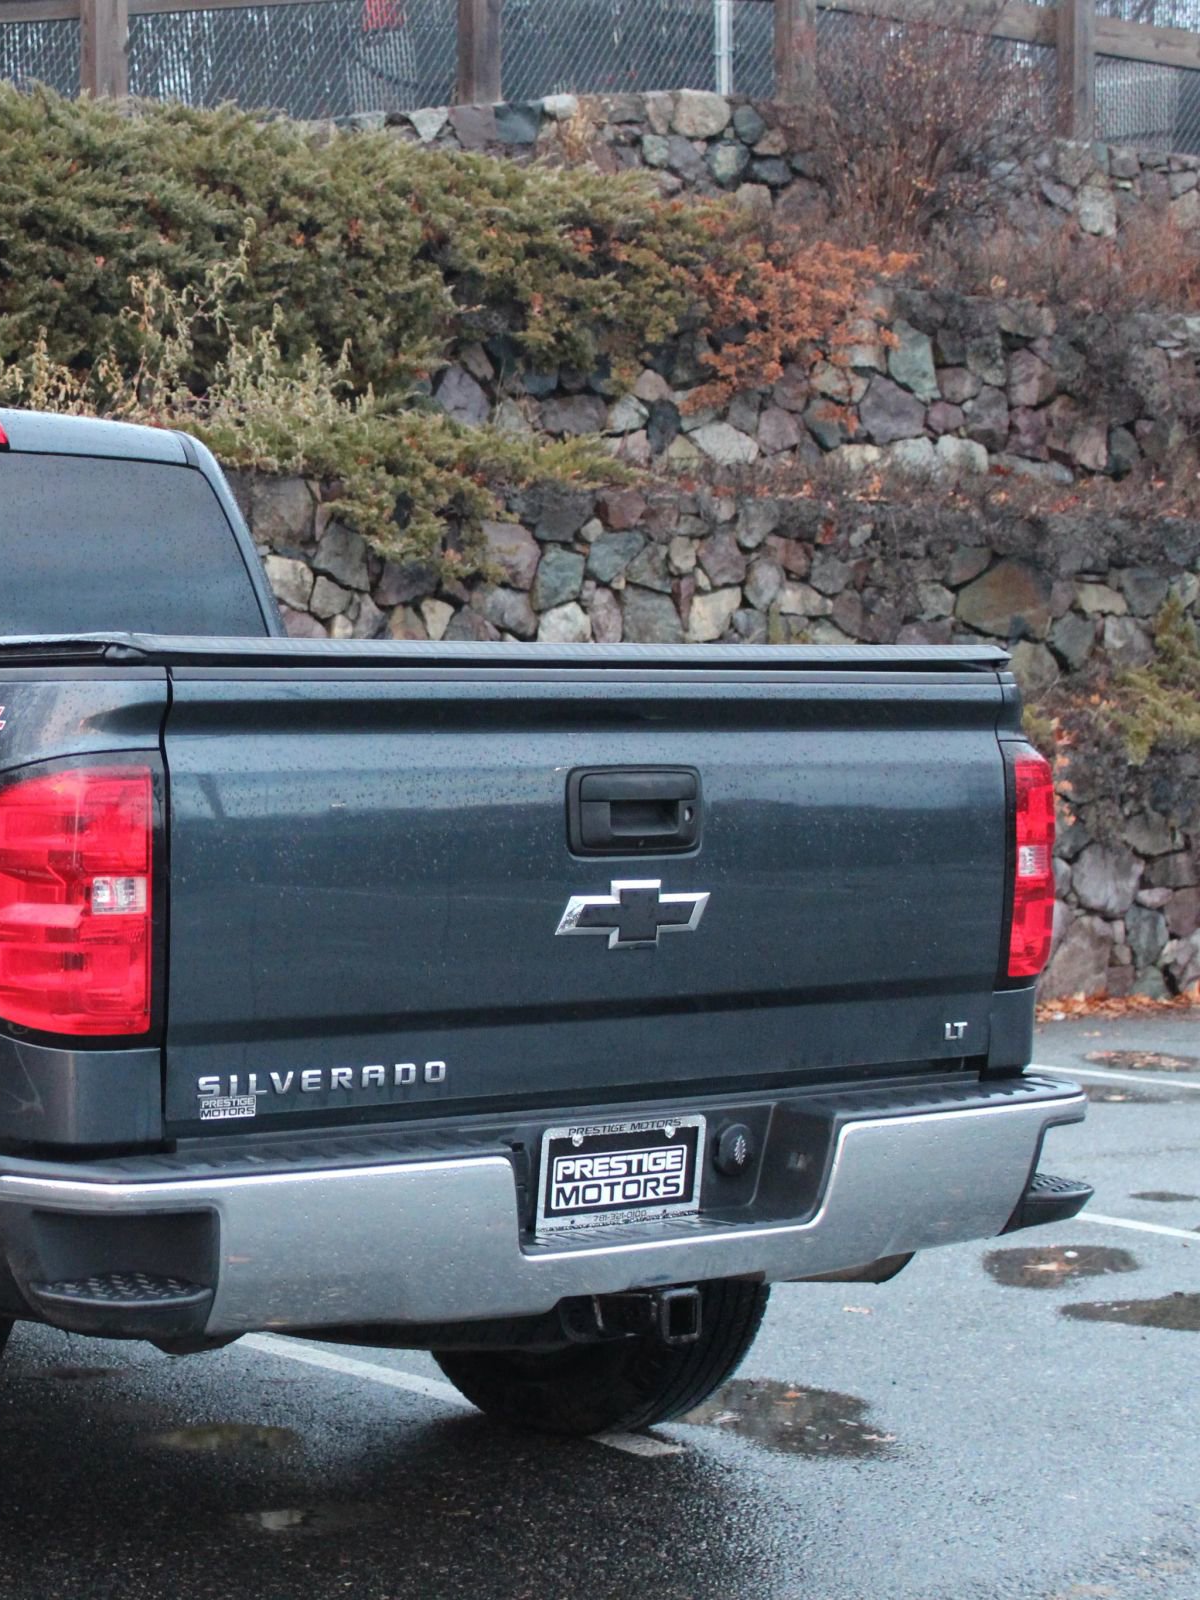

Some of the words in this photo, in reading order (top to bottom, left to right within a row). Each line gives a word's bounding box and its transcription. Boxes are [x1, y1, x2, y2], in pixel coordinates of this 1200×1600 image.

[944, 1021, 968, 1040] LT
[197, 1060, 446, 1099] SILVERADO
[201, 1106, 255, 1118] MOTORS
[202, 1096, 255, 1109] PRESTIGE
[568, 1123, 626, 1136] PRESTIGE
[630, 1118, 681, 1131] MOTORS
[556, 1149, 682, 1182] PRESTIGE
[555, 1174, 681, 1208] MOTORS
